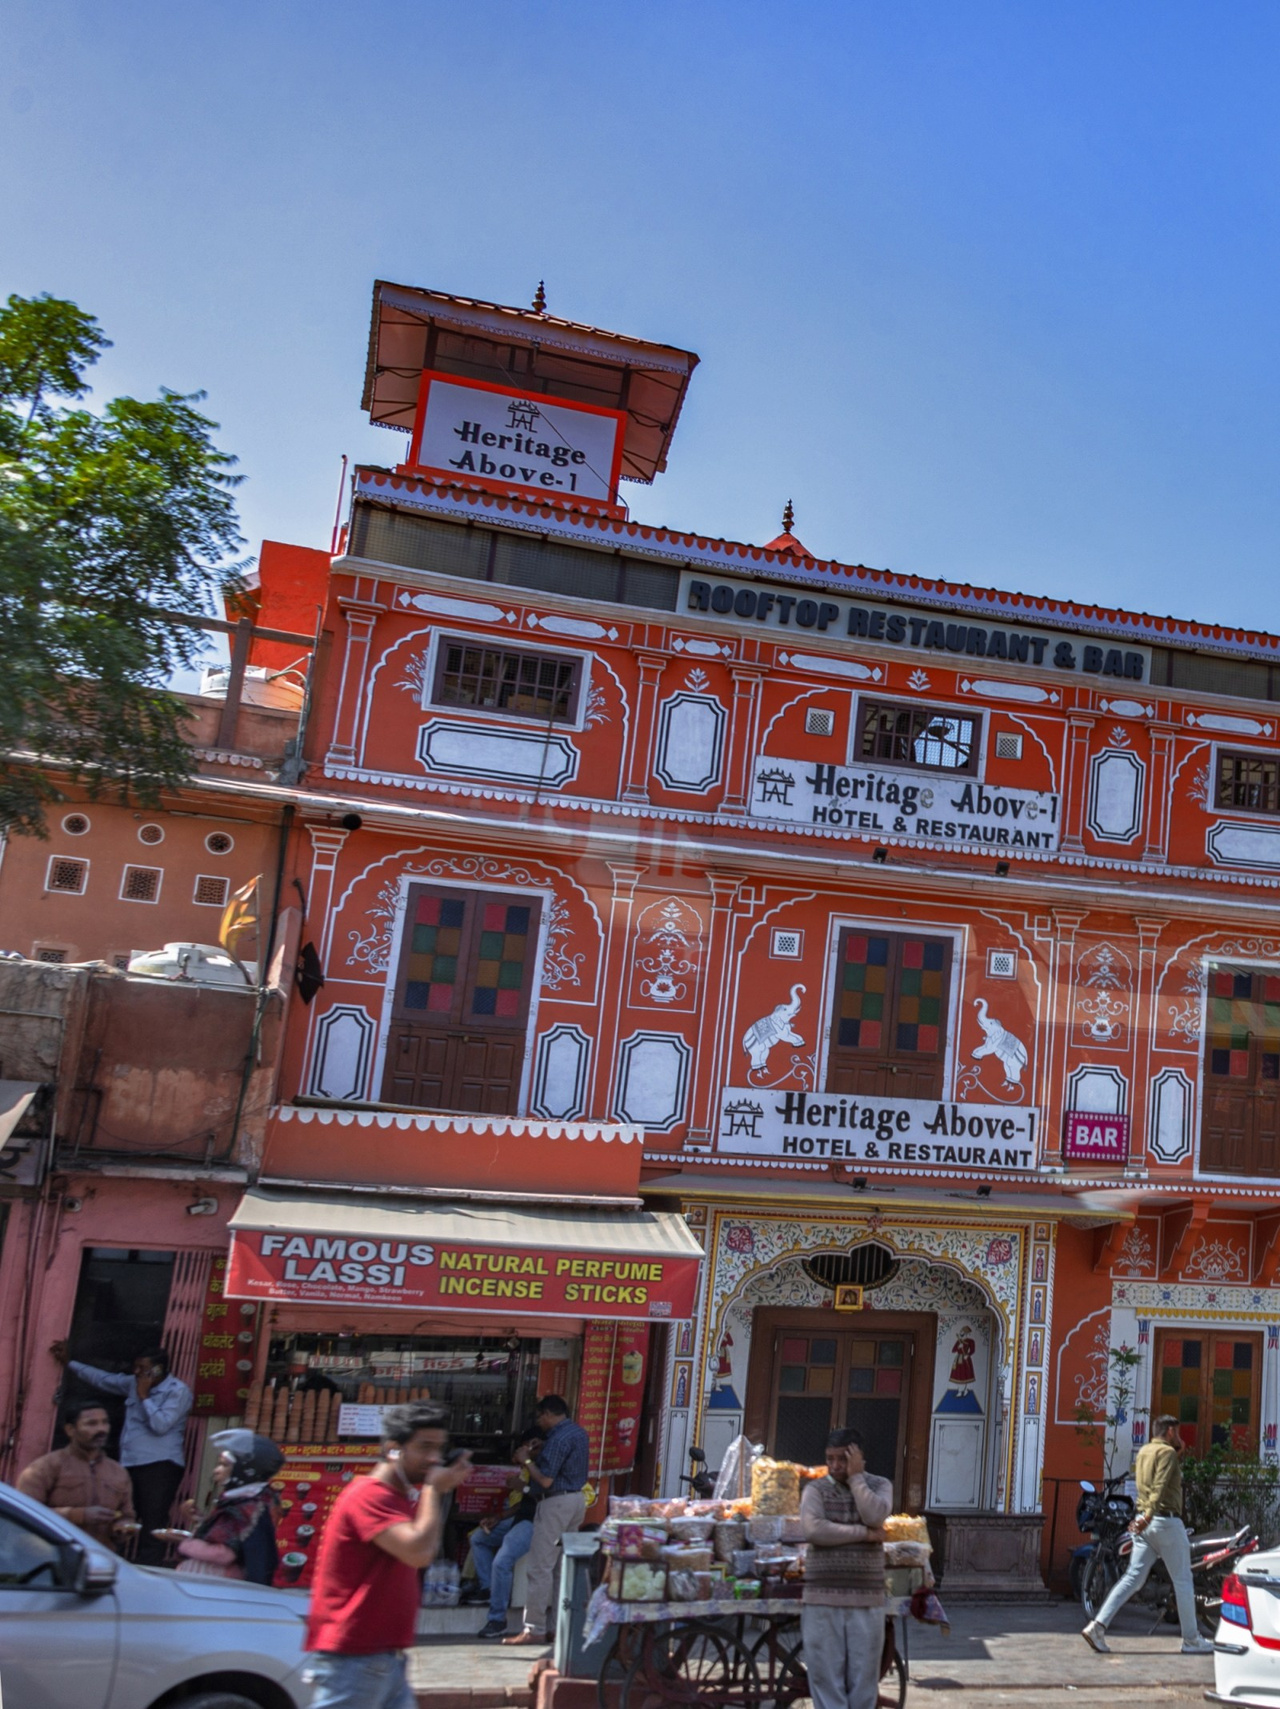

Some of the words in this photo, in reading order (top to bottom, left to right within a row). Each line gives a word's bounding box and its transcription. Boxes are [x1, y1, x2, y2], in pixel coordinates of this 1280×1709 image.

[454, 421, 585, 466] Heritage
[450, 451, 576, 491] Above-1
[688, 580, 839, 631] ROOFTOP
[849, 607, 1049, 665] RESTAURANT
[1053, 641, 1076, 669] &
[1082, 644, 1144, 679] BAR
[806, 764, 935, 815] Heritage
[951, 784, 1058, 823] Above-1
[813, 806, 883, 830] HOTEL
[893, 817, 907, 832] &
[916, 818, 1054, 849] RESTAURANT
[775, 1092, 911, 1141] Heritage
[923, 1102, 1034, 1142] Above-1
[783, 1136, 857, 1158] HOTEL
[864, 1142, 880, 1159] &
[888, 1142, 1033, 1168] RESTAURANT
[1075, 1125, 1119, 1148] BAR
[260, 1235, 435, 1266] FAMOUS
[284, 1259, 406, 1287] LASSI
[439, 1252, 550, 1277] NATURAL
[555, 1259, 664, 1283] PERFUME
[379, 1287, 424, 1296] Strawberry
[439, 1276, 543, 1300] INCENSE
[565, 1283, 648, 1305] STICKS
